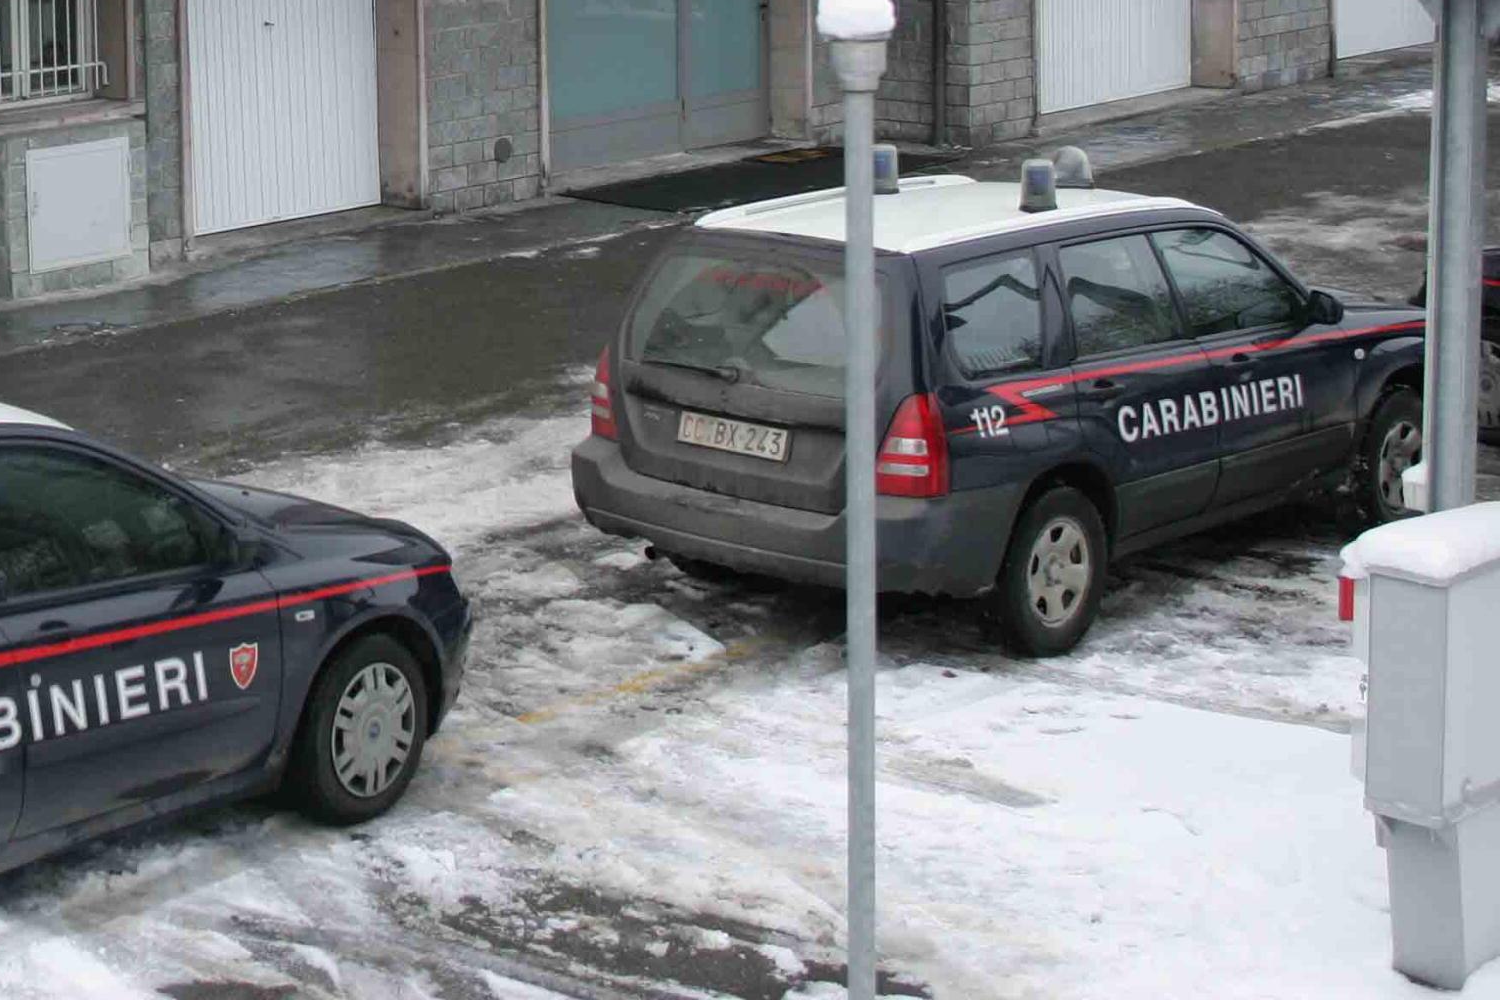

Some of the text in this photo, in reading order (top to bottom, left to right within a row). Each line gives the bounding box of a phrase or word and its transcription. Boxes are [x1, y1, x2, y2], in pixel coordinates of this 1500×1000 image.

[970, 405, 1010, 438] 112
[1117, 374, 1303, 442] CARABINIERI
[683, 415, 782, 455] CC BX 243
